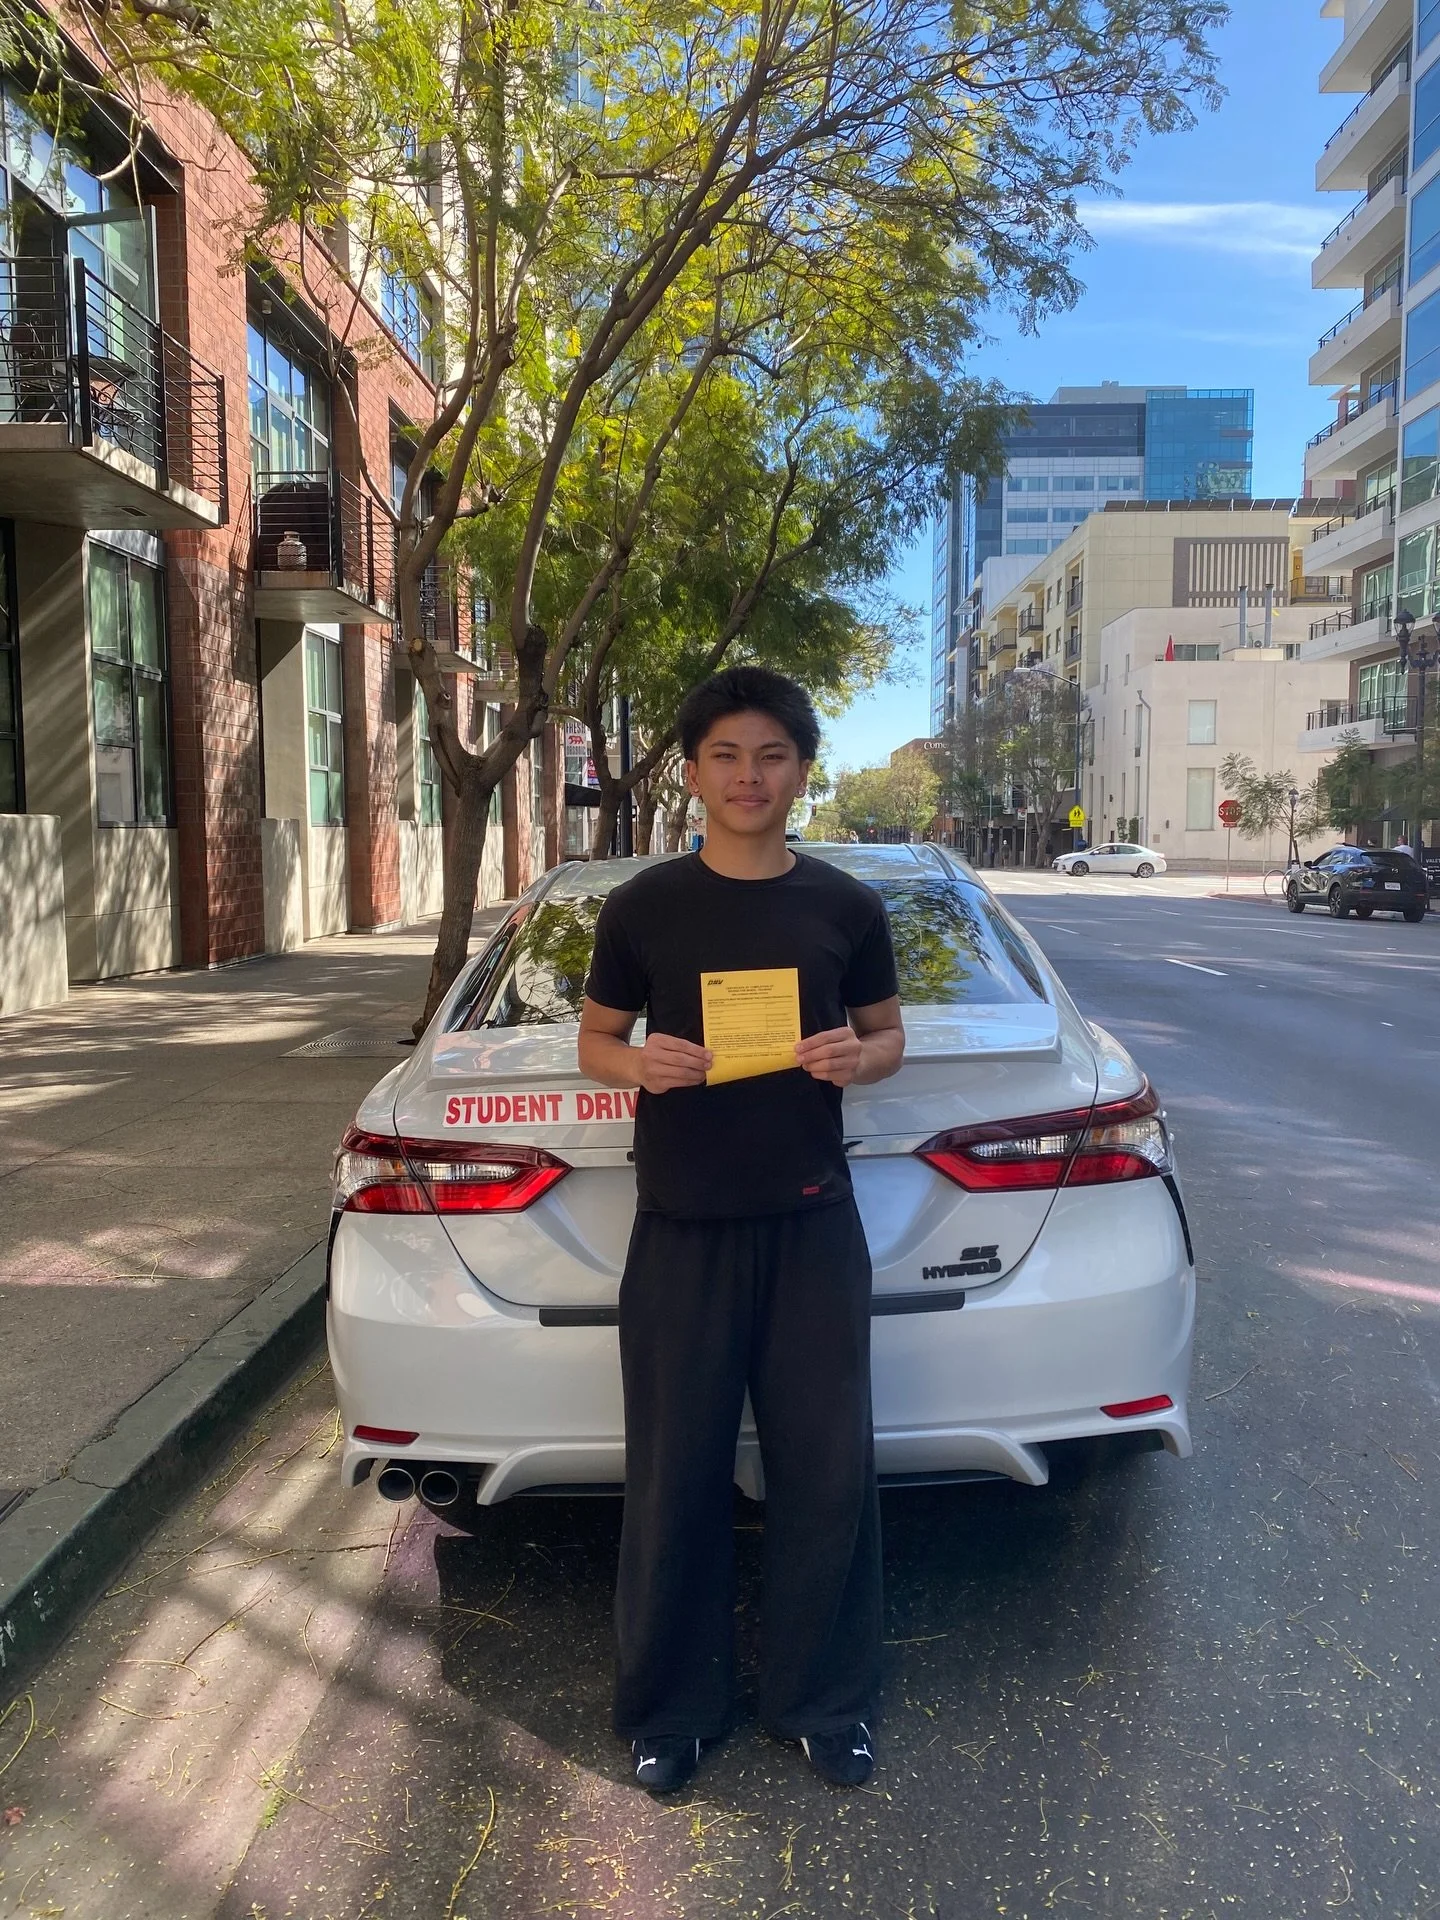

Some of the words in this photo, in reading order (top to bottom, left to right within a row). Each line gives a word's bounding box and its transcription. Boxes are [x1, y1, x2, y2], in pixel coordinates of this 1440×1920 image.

[566, 722, 586, 734] FRESH
[1219, 806, 1241, 816] STOP
[445, 1094, 563, 1125] STUDENT
[959, 1244, 999, 1261] SE
[922, 1260, 989, 1280] HYBRID
